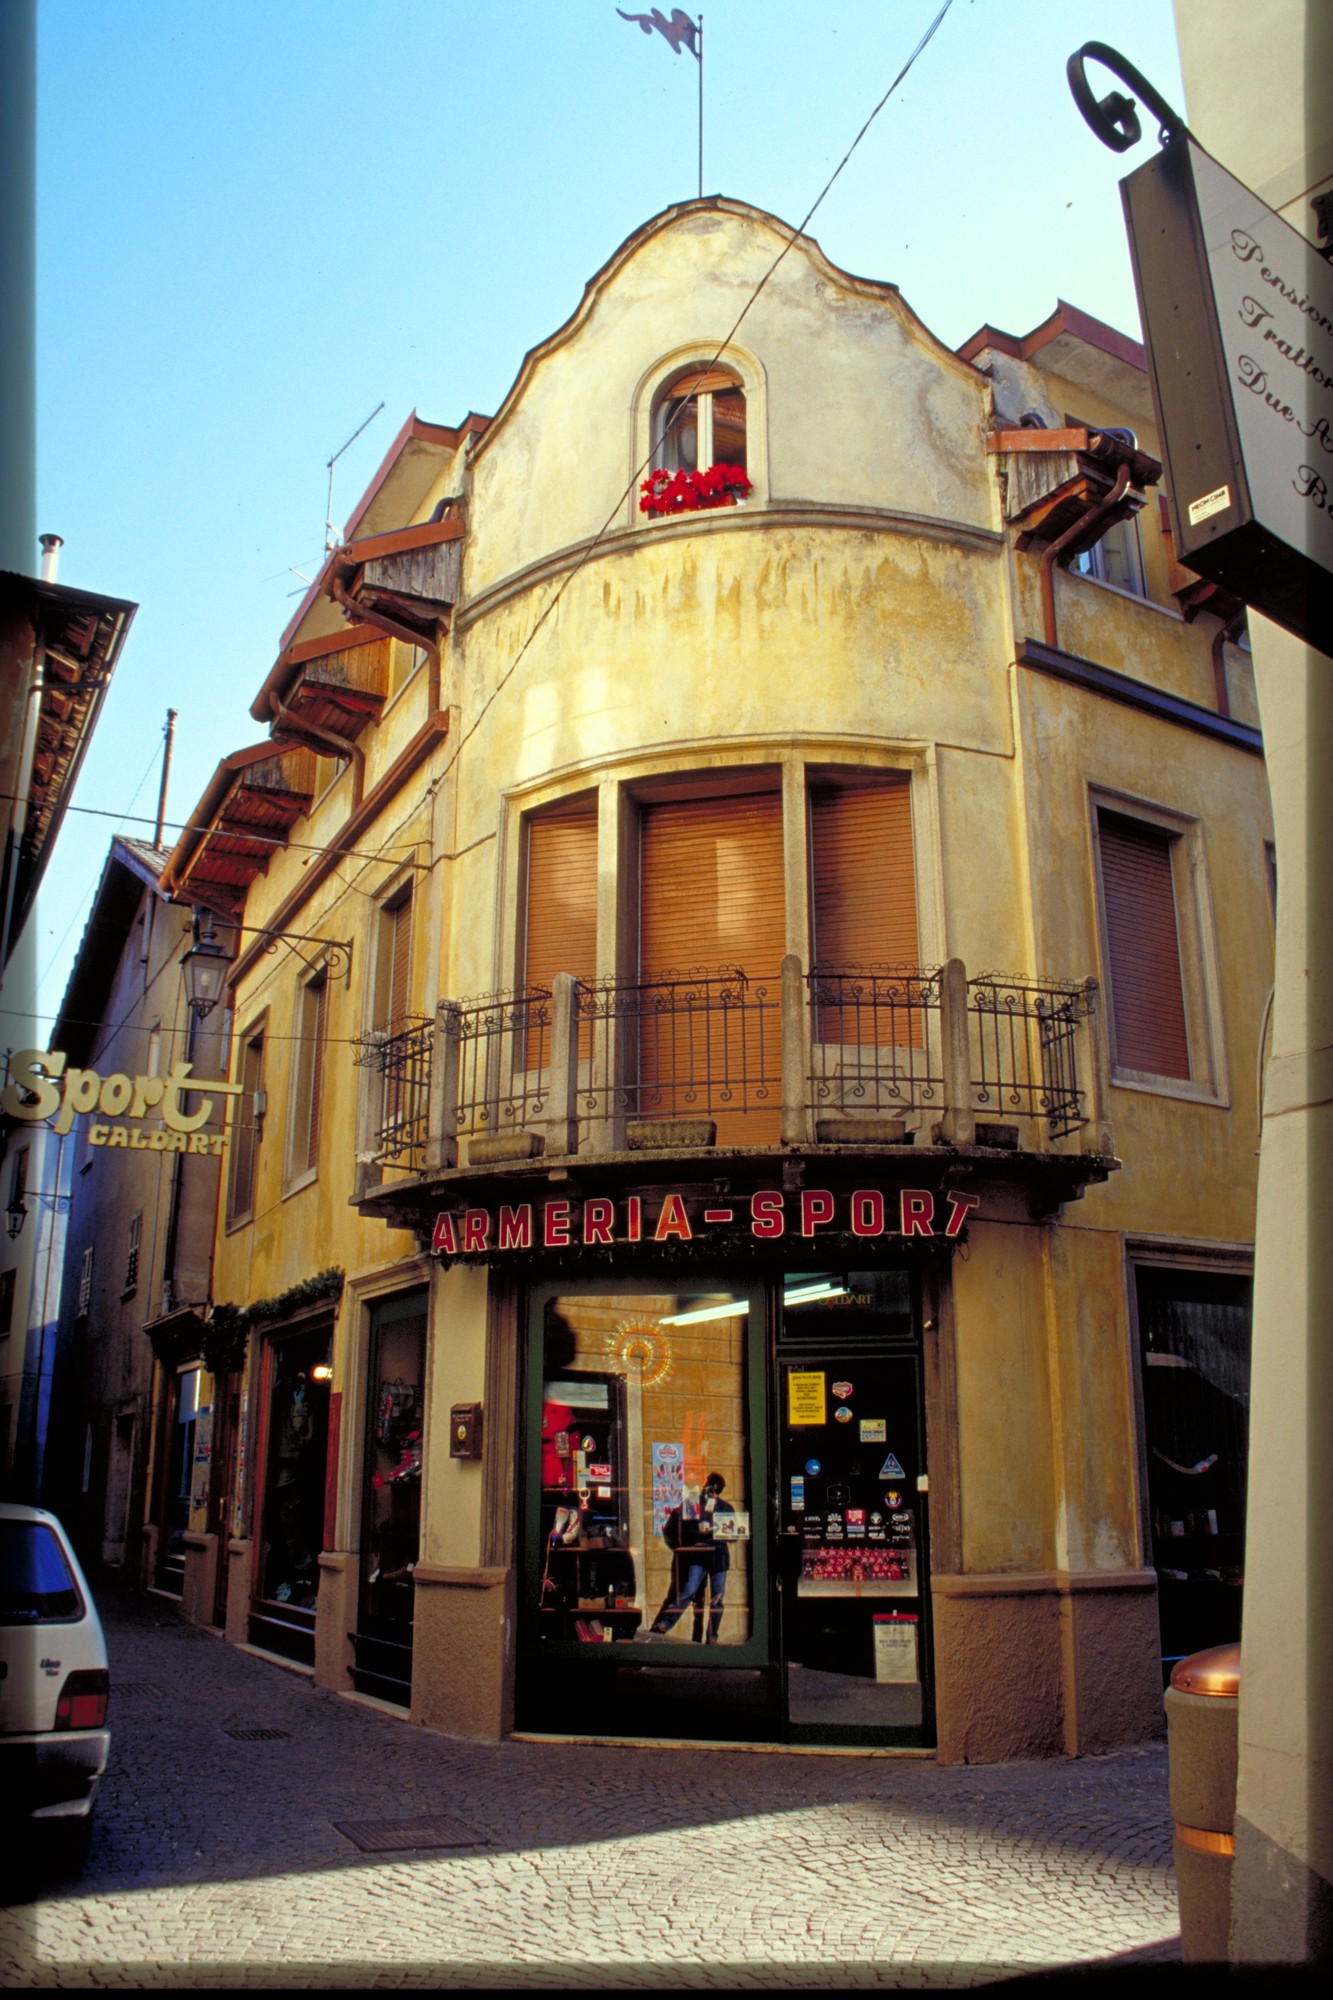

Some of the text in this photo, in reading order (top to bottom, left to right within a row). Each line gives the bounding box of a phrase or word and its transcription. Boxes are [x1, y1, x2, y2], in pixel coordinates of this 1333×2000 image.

[1238, 354, 1295, 423] Due
[1, 1049, 244, 1136] Sport
[88, 1123, 231, 1156] CALDART
[818, 1294, 873, 1306] CALDART
